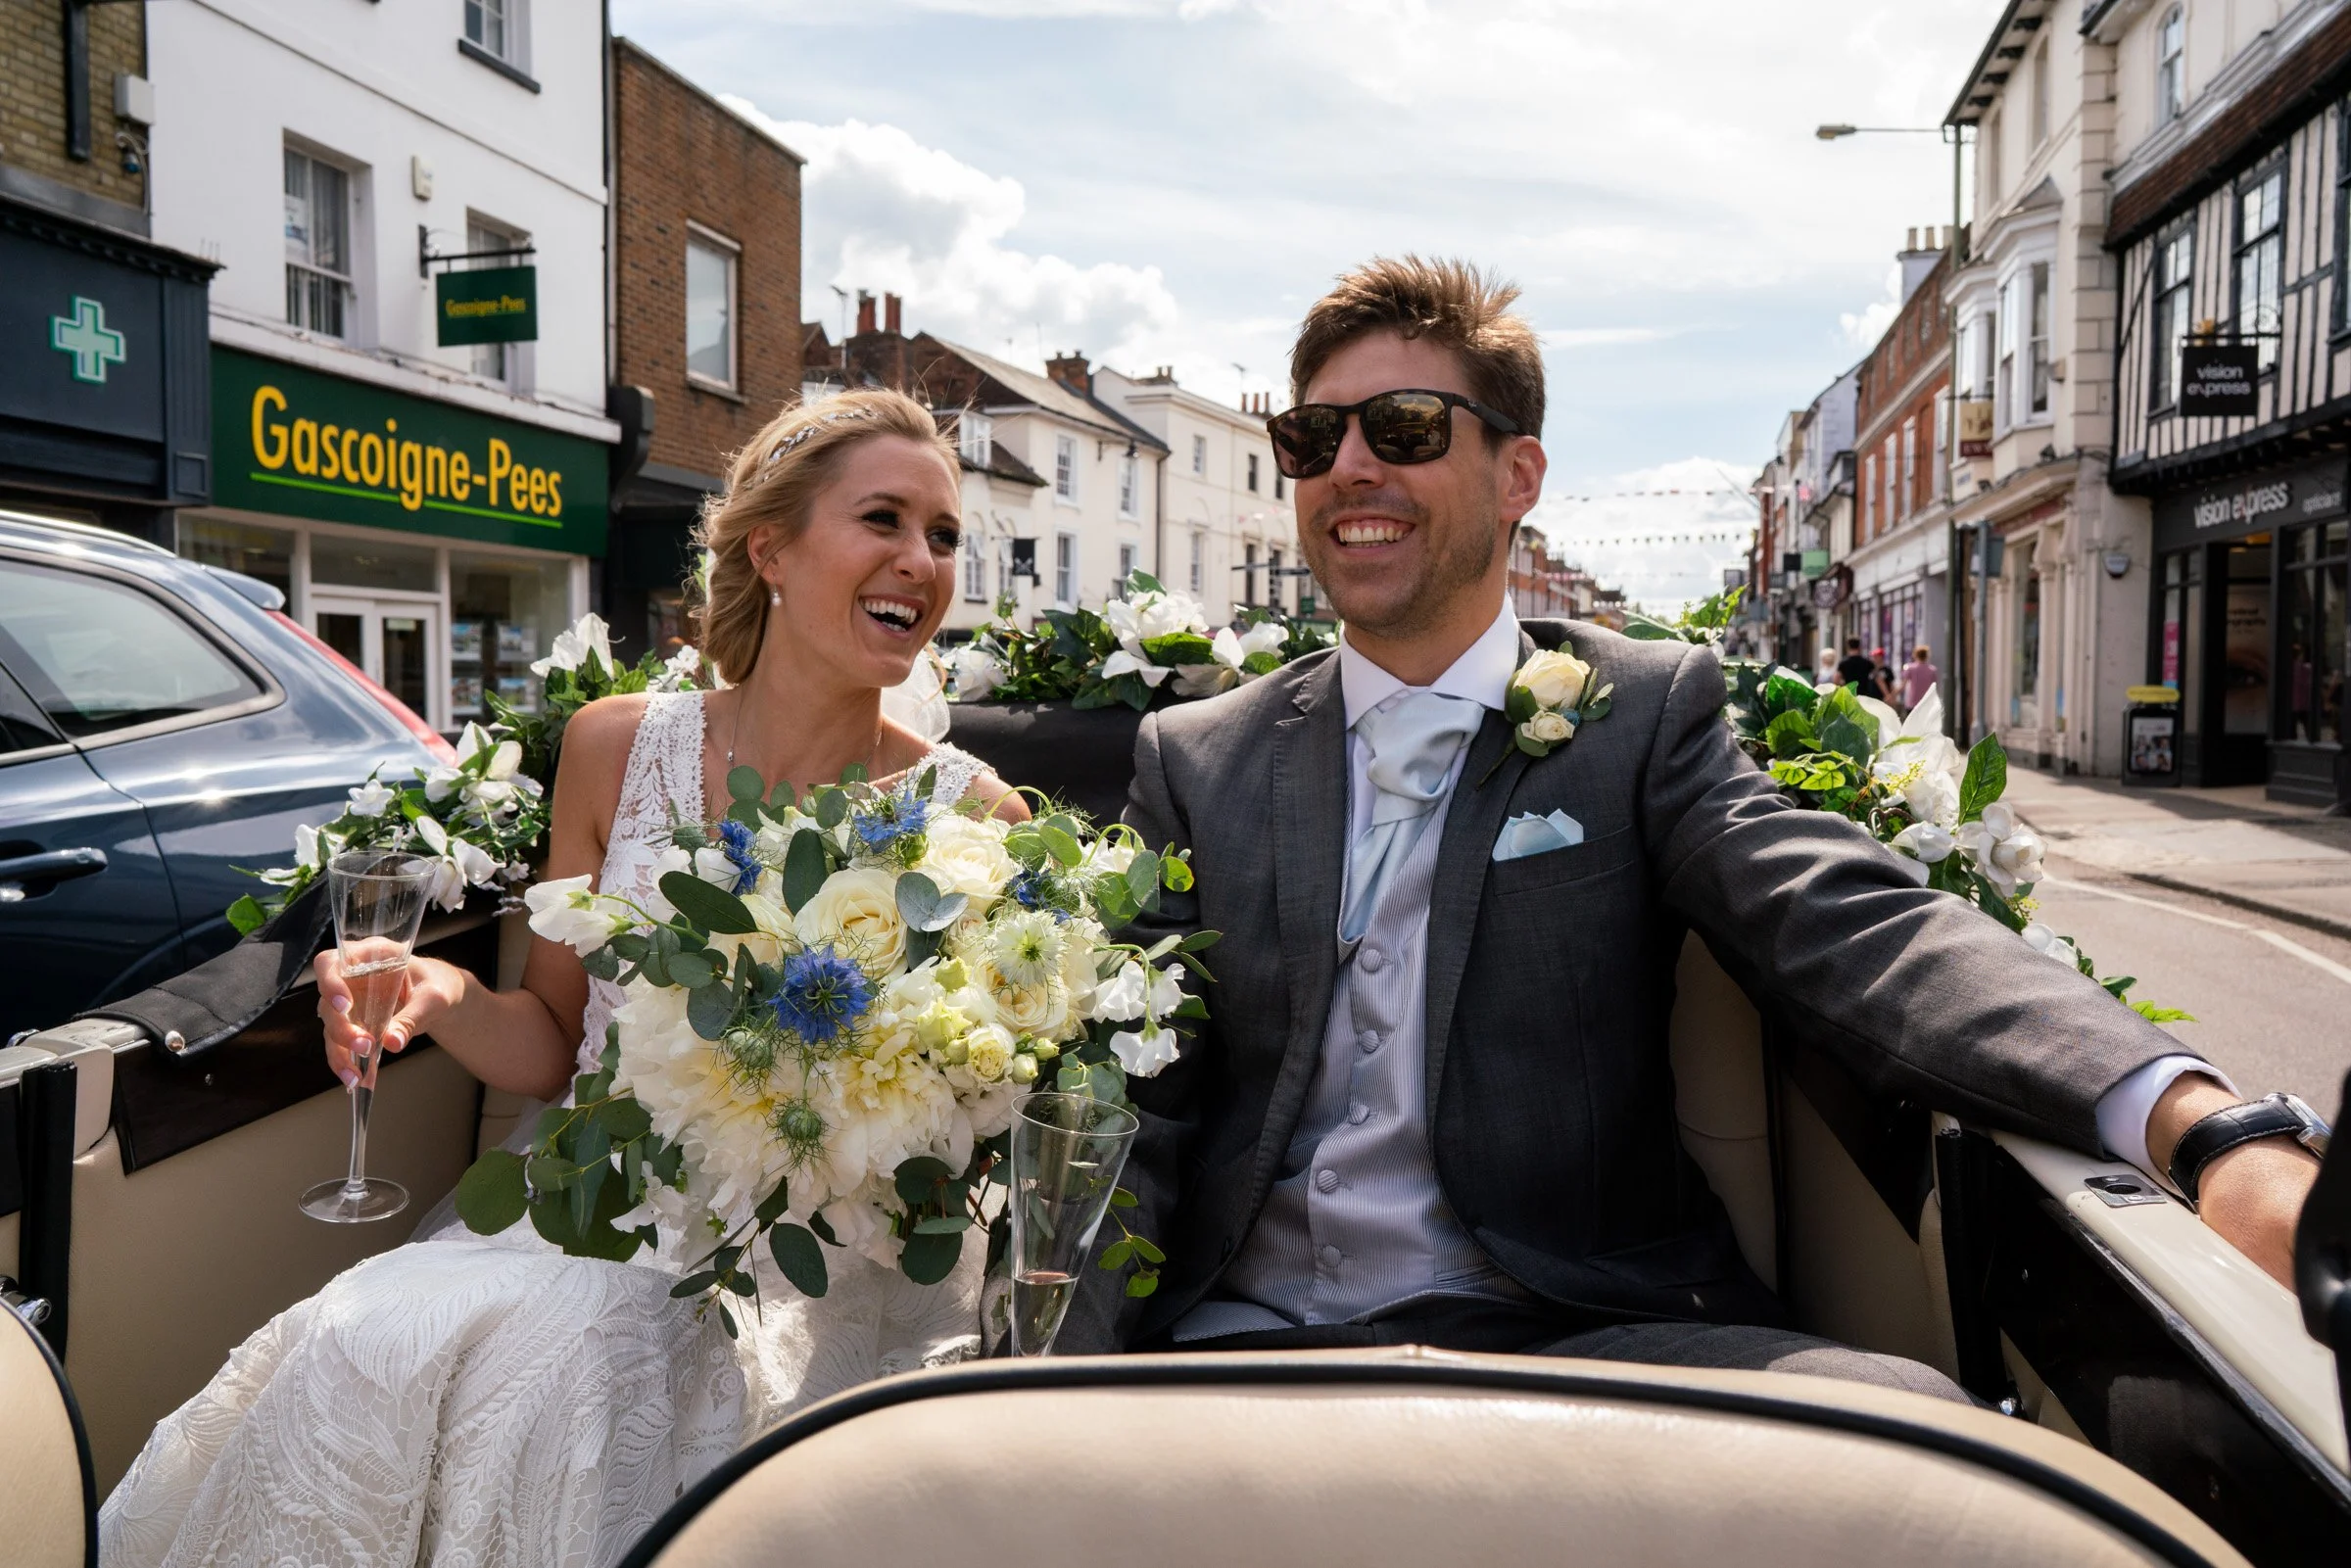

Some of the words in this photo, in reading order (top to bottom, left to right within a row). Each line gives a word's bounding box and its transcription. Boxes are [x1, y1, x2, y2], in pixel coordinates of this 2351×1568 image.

[446, 295, 526, 317] Gascoigne-Pees
[2196, 363, 2243, 380] vision
[2186, 381, 2251, 399] express
[252, 385, 563, 517] Gascoigne-Pees
[2194, 494, 2231, 528] vision
[2231, 482, 2289, 524] express
